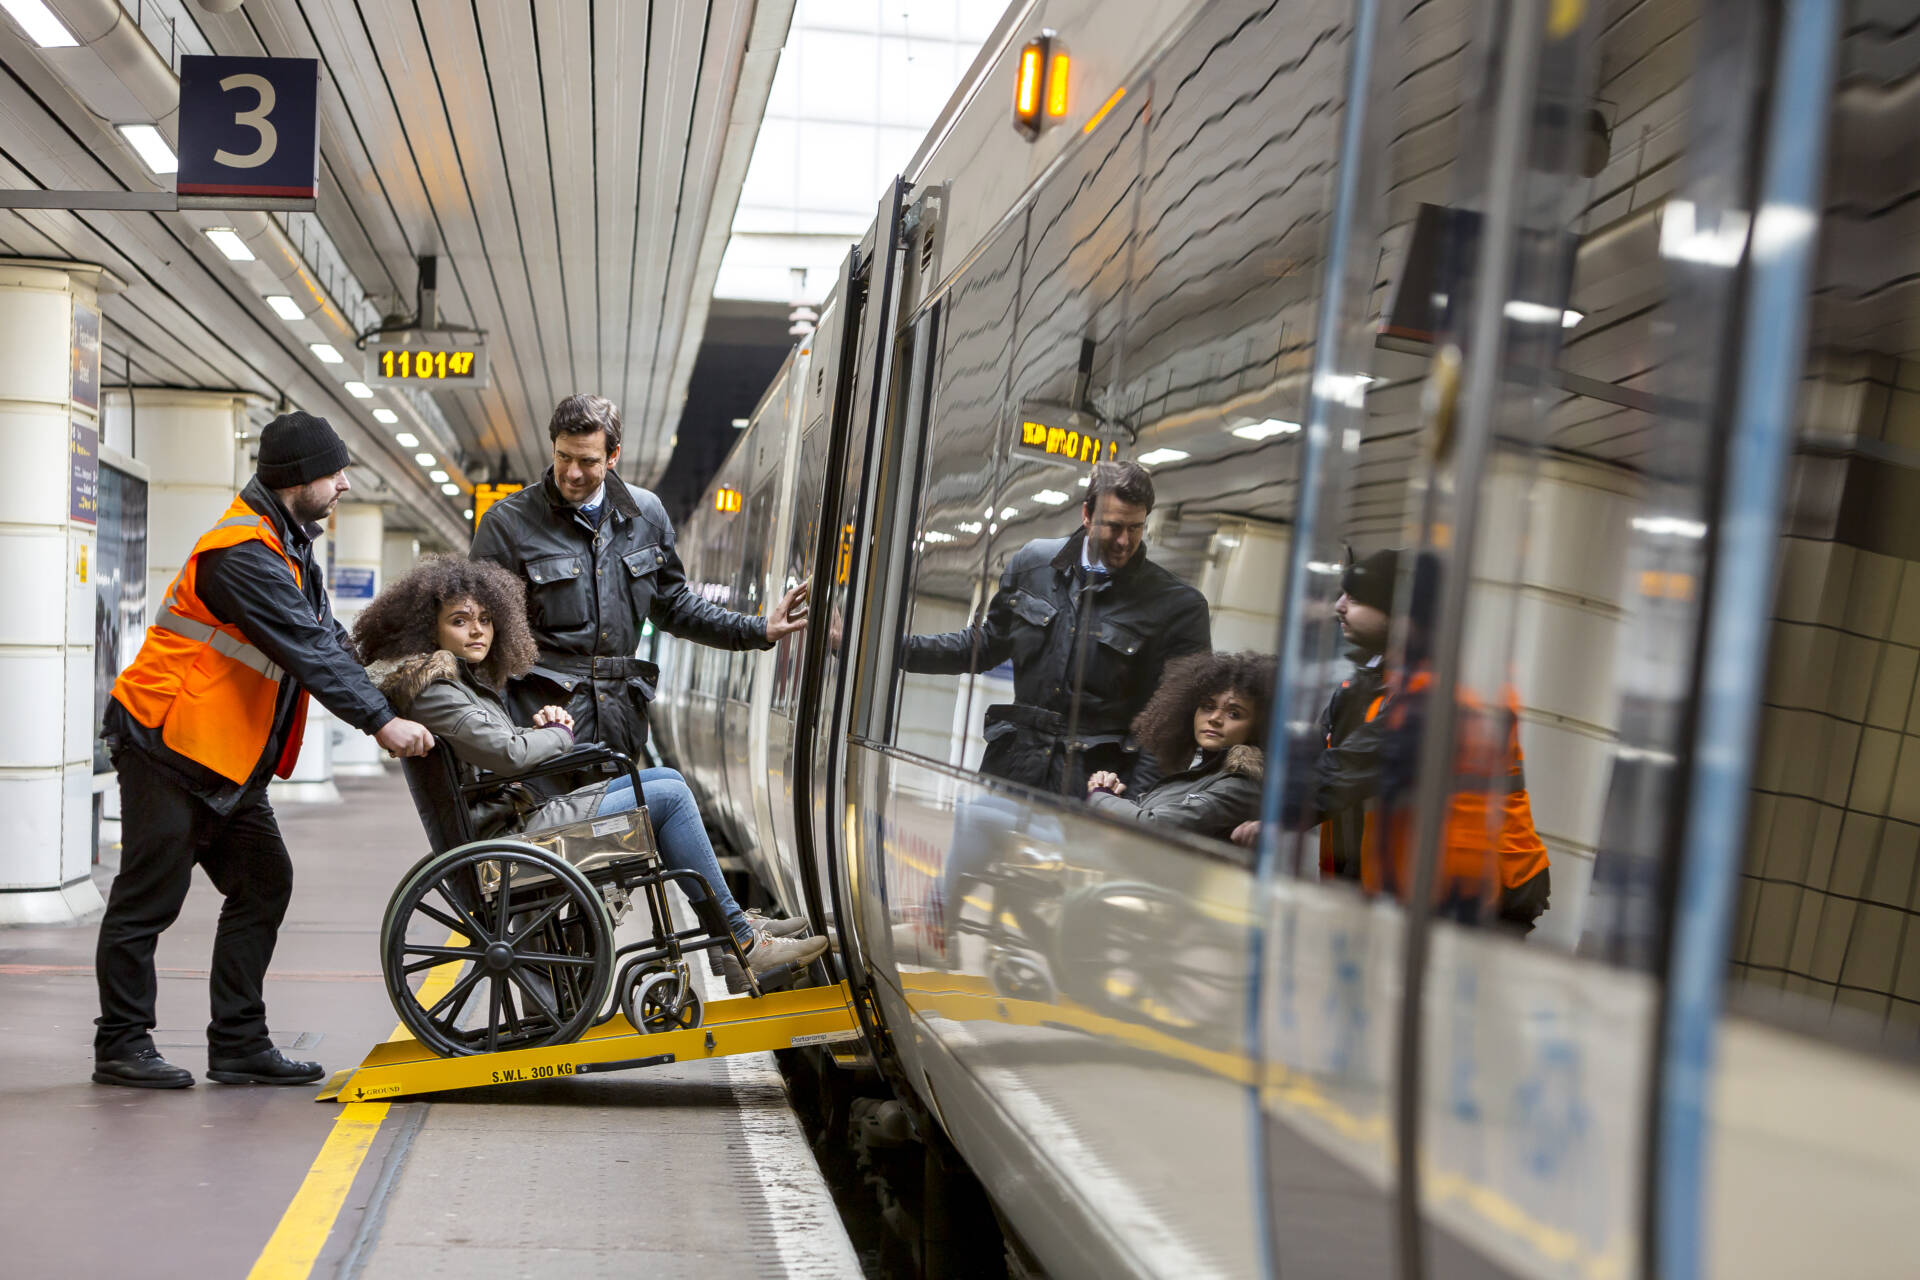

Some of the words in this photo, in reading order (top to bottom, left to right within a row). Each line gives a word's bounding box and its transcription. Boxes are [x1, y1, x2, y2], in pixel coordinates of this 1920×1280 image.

[213, 73, 278, 169] 3
[492, 1069, 528, 1083] S.W.L.
[531, 1065, 554, 1079] 300
[556, 1062, 573, 1076] KG
[366, 1086, 400, 1096] GROUND
